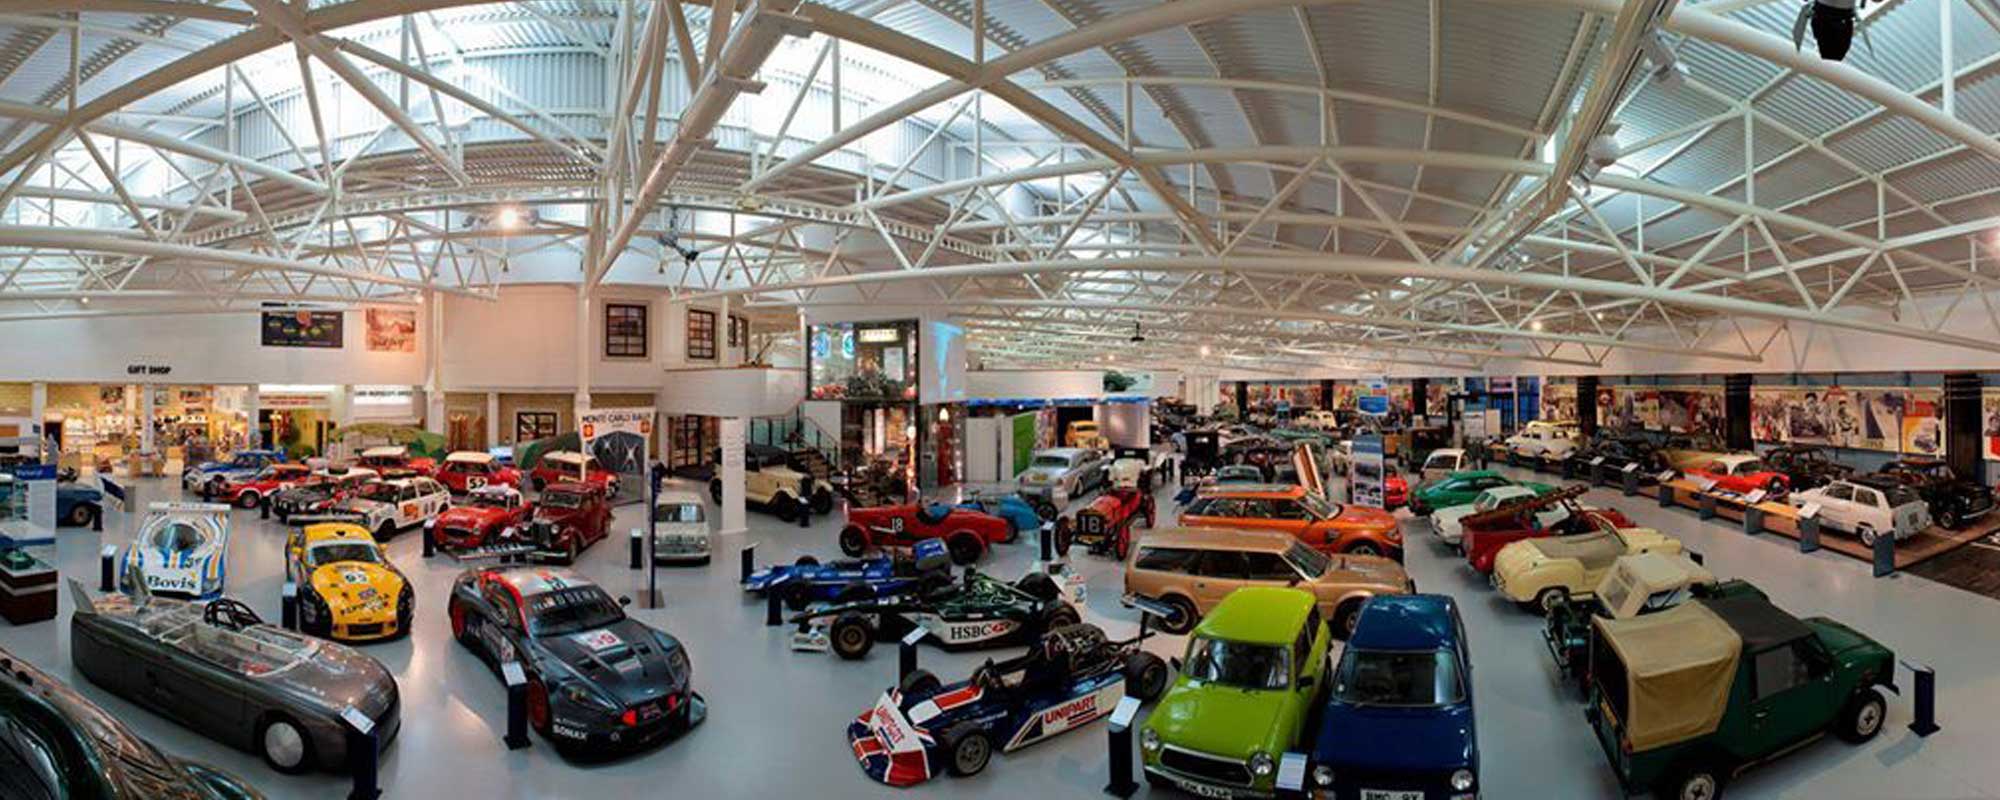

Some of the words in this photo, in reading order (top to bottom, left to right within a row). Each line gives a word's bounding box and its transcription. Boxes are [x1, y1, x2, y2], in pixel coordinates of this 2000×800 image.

[127, 365, 146, 375] GIFT
[148, 366, 171, 375] SHOP
[1080, 515, 1100, 533] 18
[148, 575, 196, 589] Bovis
[950, 624, 992, 640] HSBC
[1044, 694, 1097, 724] UNIPART
